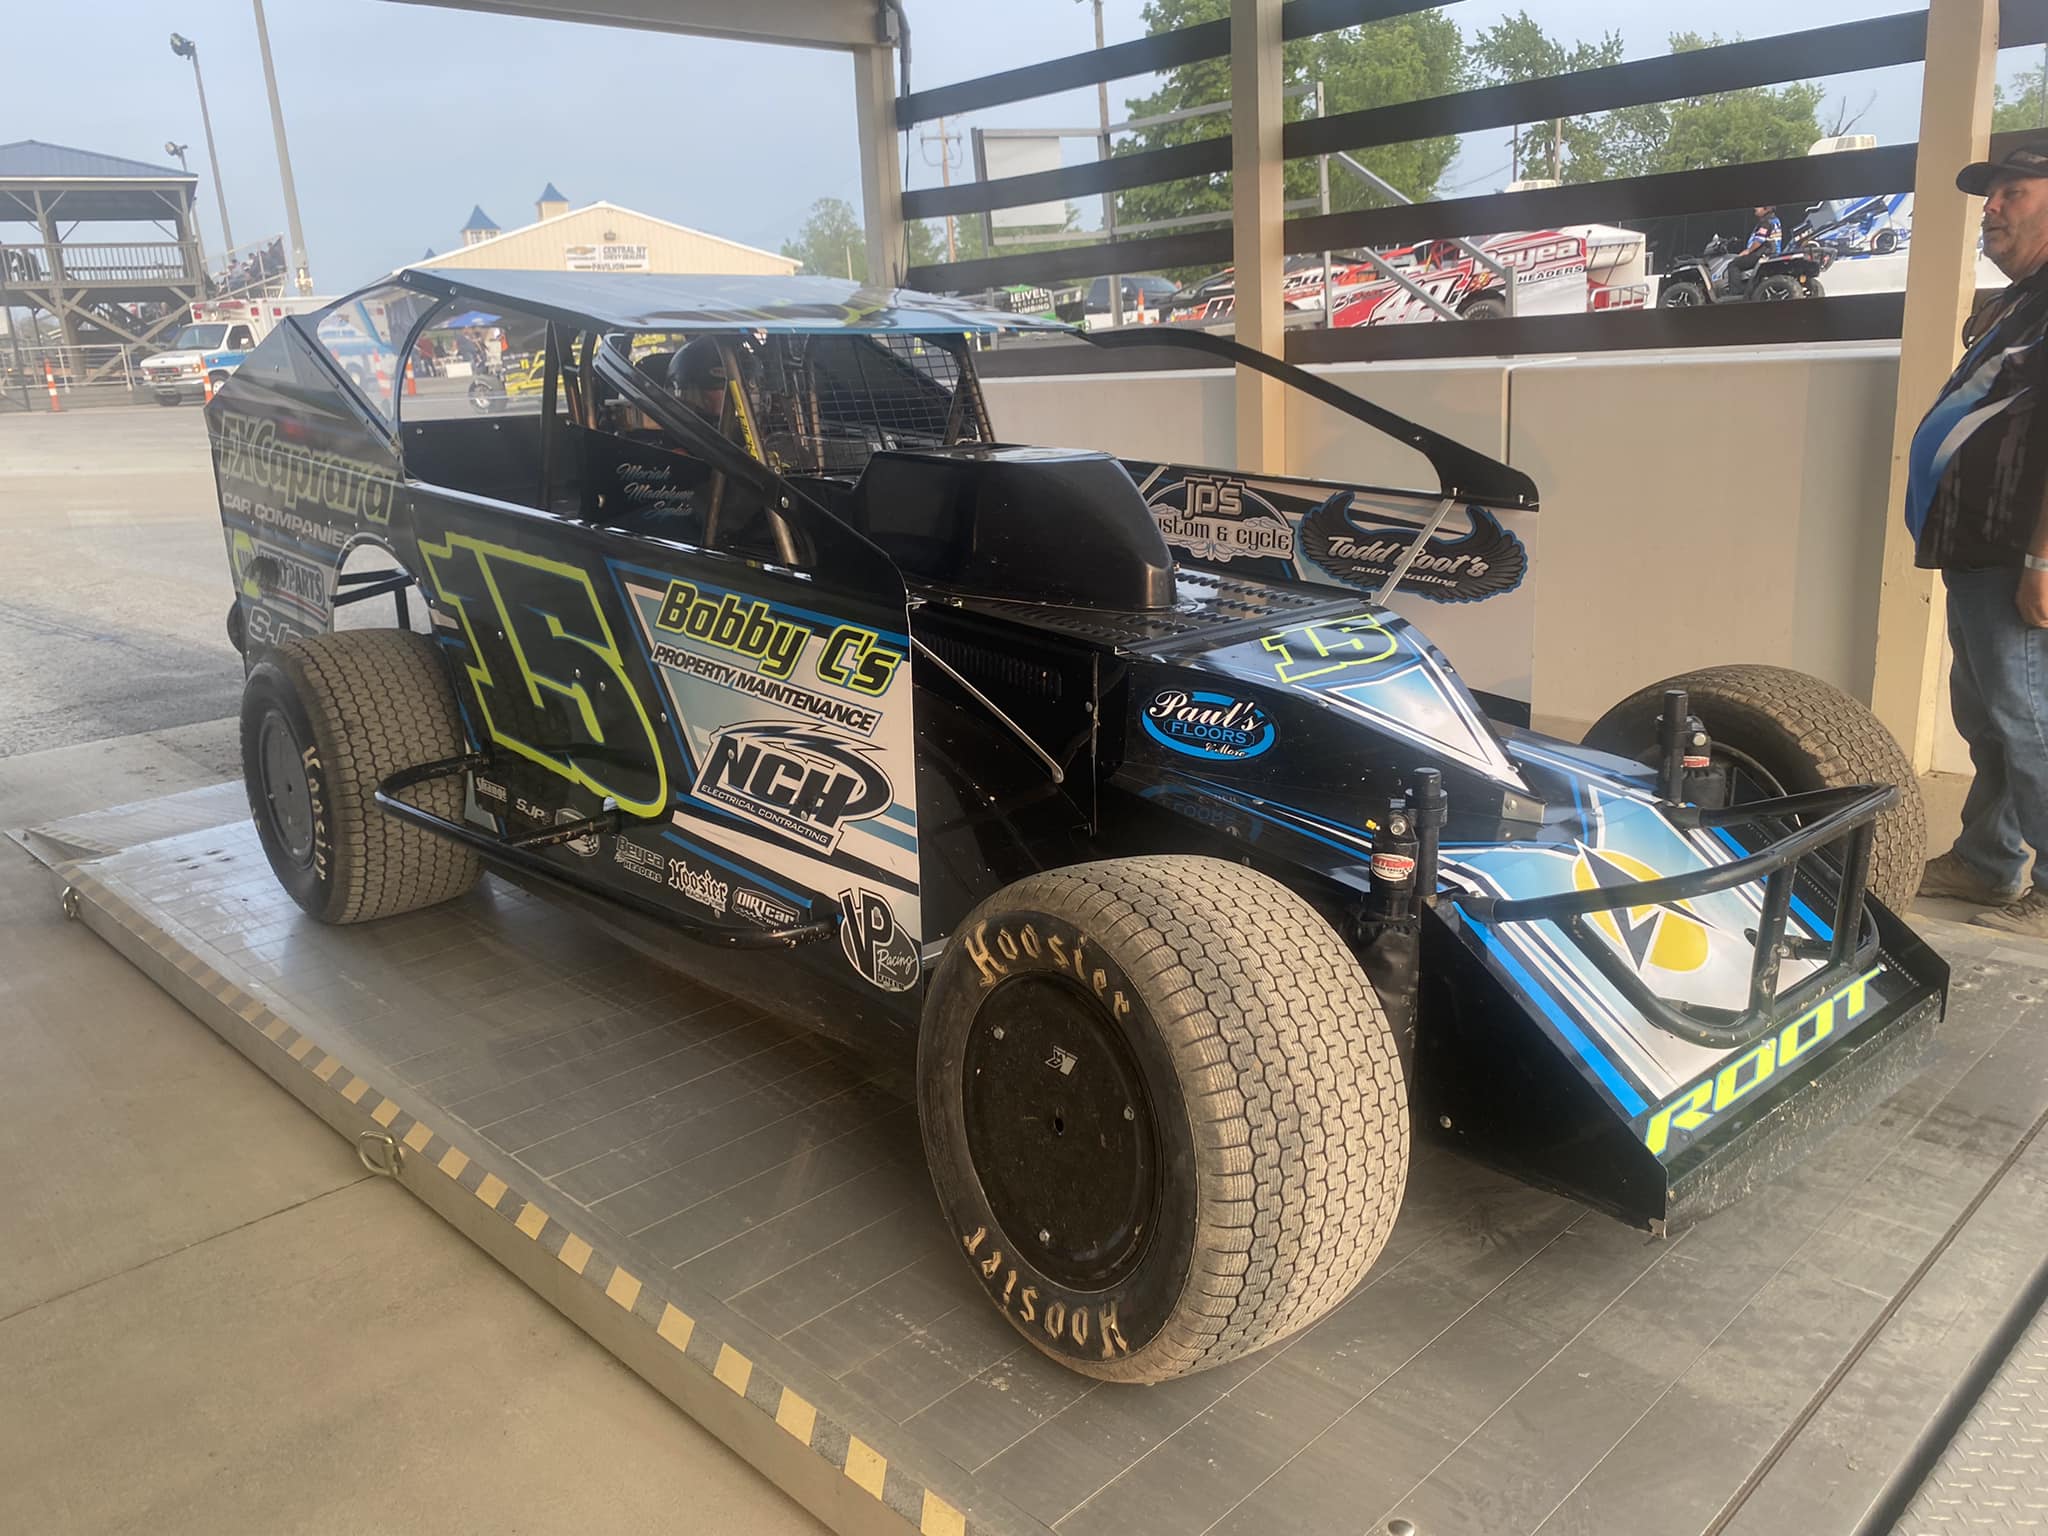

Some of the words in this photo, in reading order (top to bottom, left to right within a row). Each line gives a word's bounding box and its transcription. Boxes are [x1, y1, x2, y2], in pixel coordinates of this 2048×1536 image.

[1517, 265, 1585, 283] HEADERS
[222, 492, 251, 514] CAR
[1216, 526, 1228, 541] &
[1328, 536, 1400, 563] Todd
[1352, 565, 1386, 576] auto
[1387, 569, 1459, 588] tailing
[655, 578, 814, 680] Bobby
[815, 624, 903, 697] C's
[1259, 614, 1398, 684] 15
[417, 531, 667, 818] 15
[653, 645, 737, 686] PROPERTY
[735, 673, 876, 732] MAINTENANCE
[1149, 690, 1264, 732] Paul's
[1171, 721, 1247, 744] FLOORS
[701, 784, 756, 813] ELECTRICAL
[758, 807, 829, 845] CONTRACTING
[615, 835, 665, 869] Beyea
[668, 858, 729, 902] Hoosier
[737, 891, 796, 925] DIRTcar
[838, 888, 895, 982] VP
[877, 949, 916, 975] Racing
[1645, 966, 1882, 1156] ROOT
